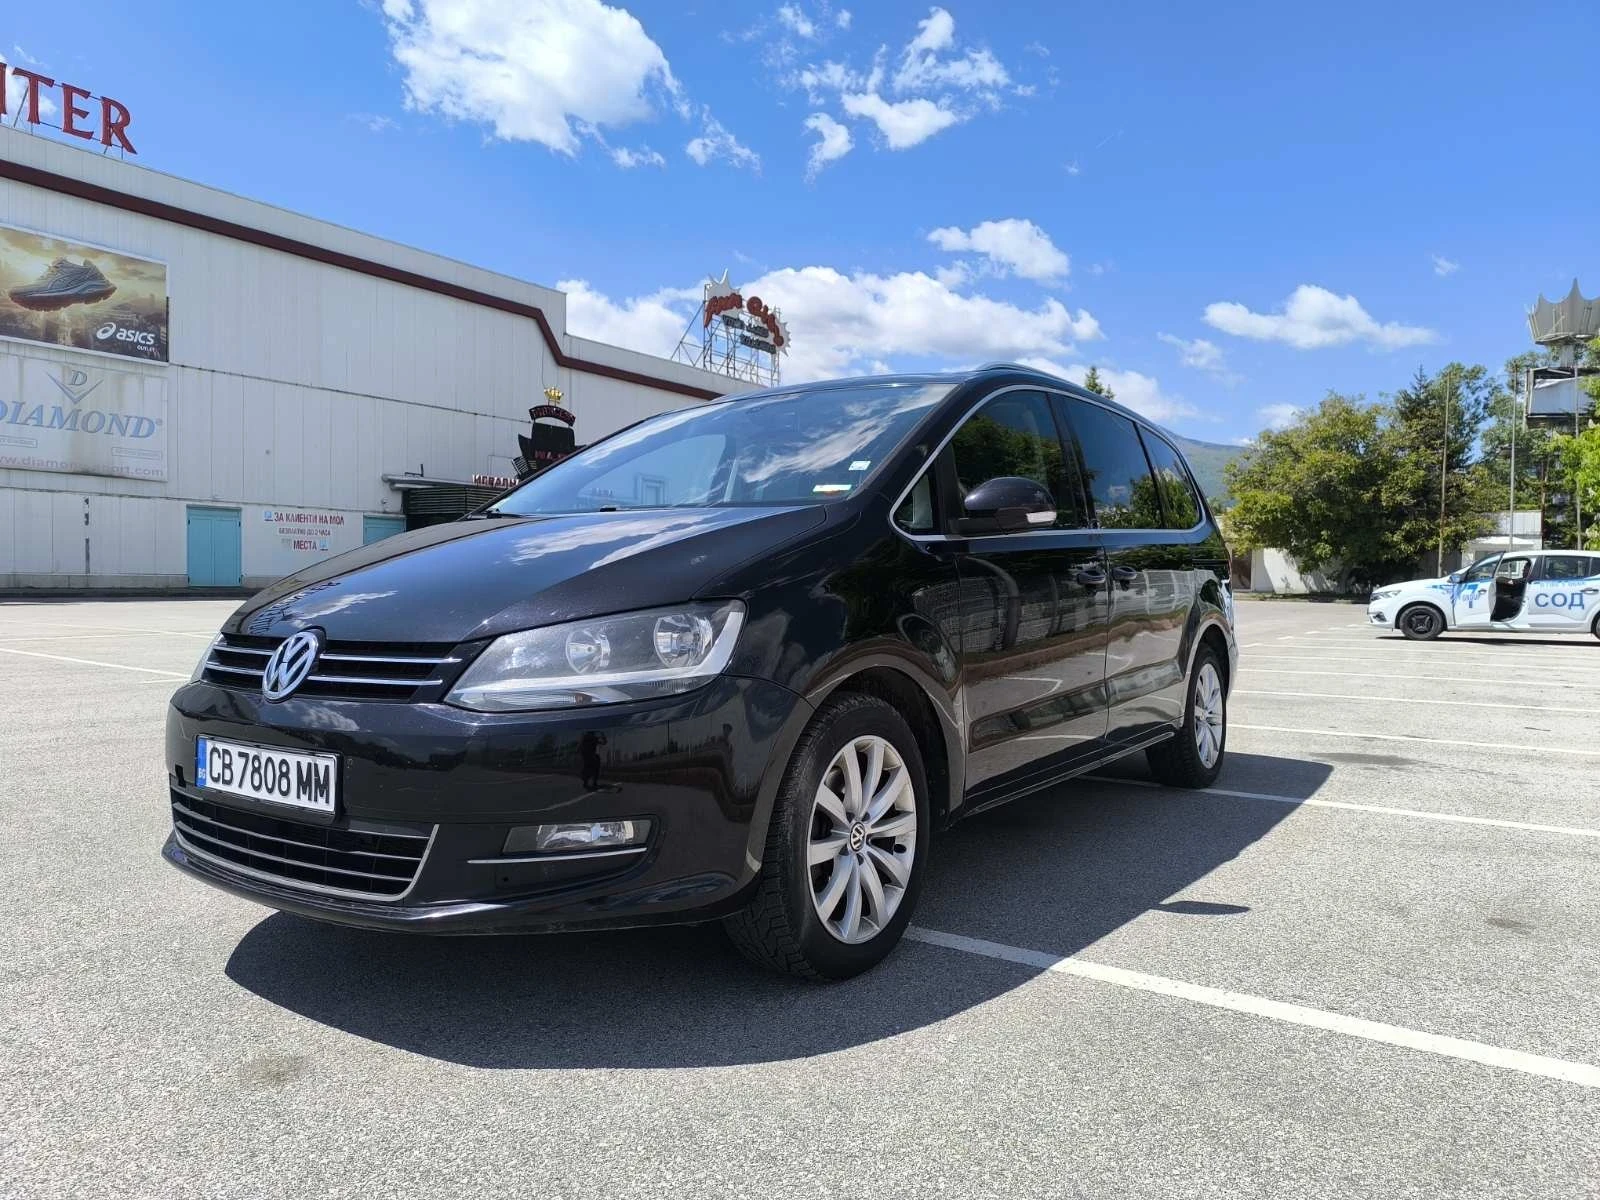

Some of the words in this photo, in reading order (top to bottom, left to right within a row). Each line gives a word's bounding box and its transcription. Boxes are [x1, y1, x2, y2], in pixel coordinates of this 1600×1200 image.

[116, 328, 155, 345] asics
[274, 512, 284, 521] ЗА
[286, 513, 317, 524] КЛИЕНТИ
[319, 515, 328, 524] НА
[293, 540, 317, 550] МЕСТА
[1535, 592, 1584, 610] СОД
